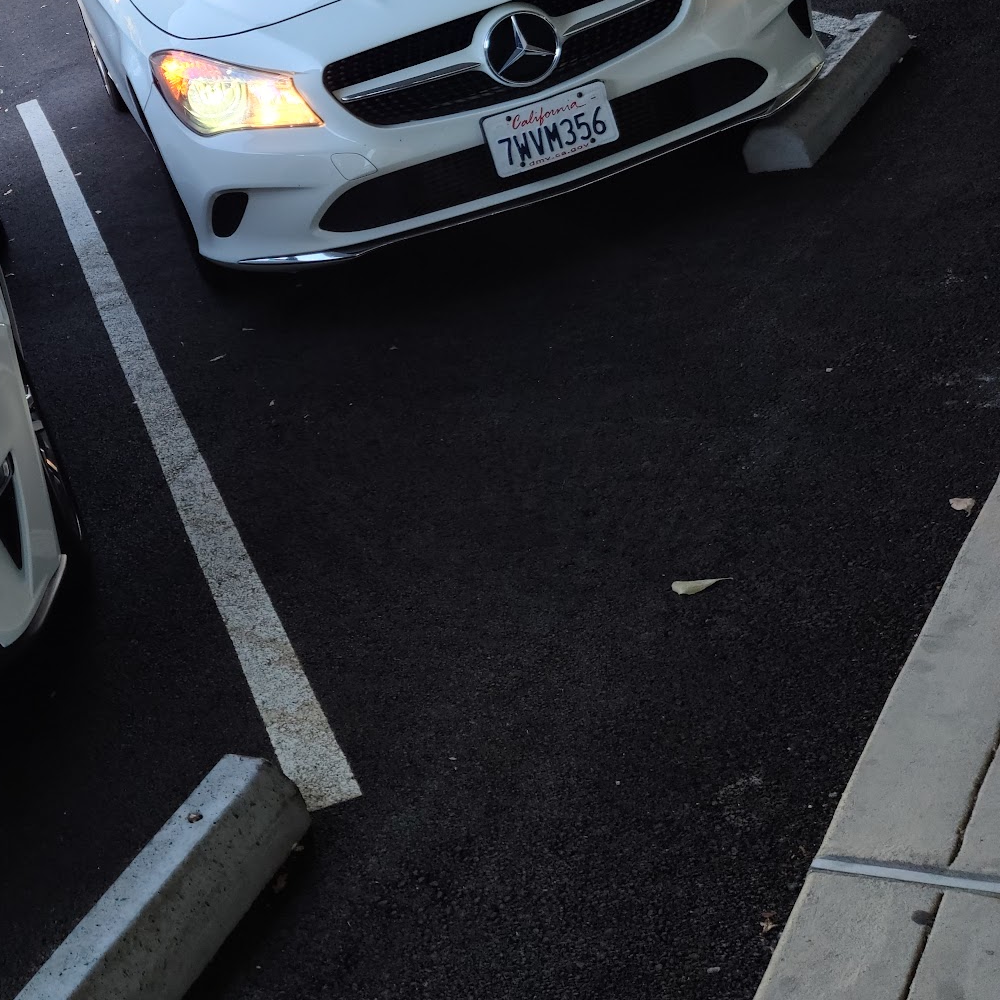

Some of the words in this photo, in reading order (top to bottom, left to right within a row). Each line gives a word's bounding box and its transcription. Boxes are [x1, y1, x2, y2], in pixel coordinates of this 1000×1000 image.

[511, 100, 586, 130] California
[497, 106, 607, 166] 7WVM356
[528, 142, 590, 167] dmv.ca.gov
